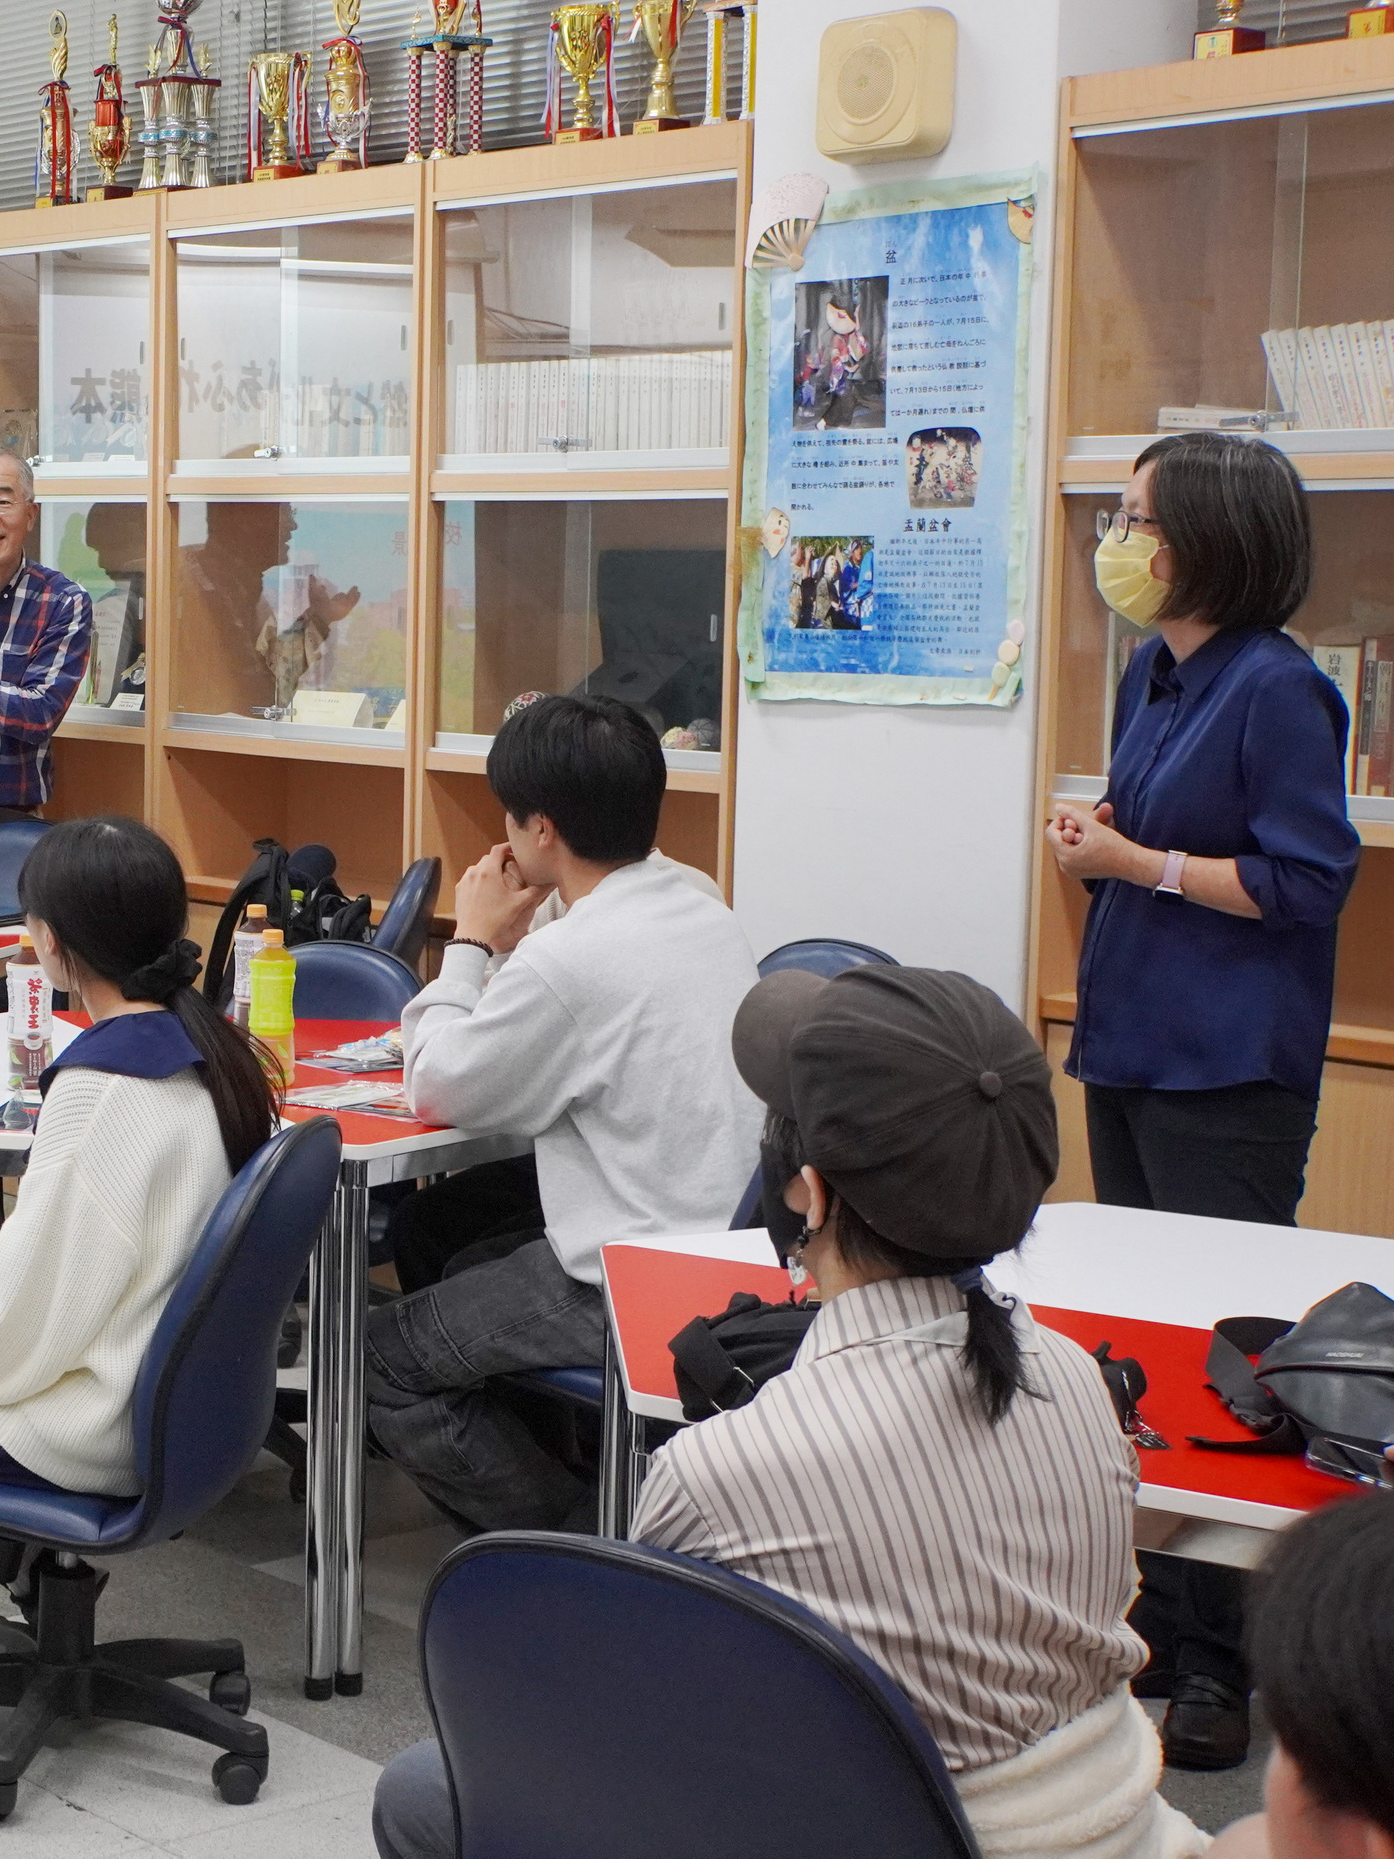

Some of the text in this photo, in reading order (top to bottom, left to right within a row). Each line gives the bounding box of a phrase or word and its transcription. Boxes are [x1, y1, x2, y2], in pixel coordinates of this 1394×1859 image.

[885, 249, 898, 264] 盆
[903, 517, 952, 533] 盂蘭盆會
